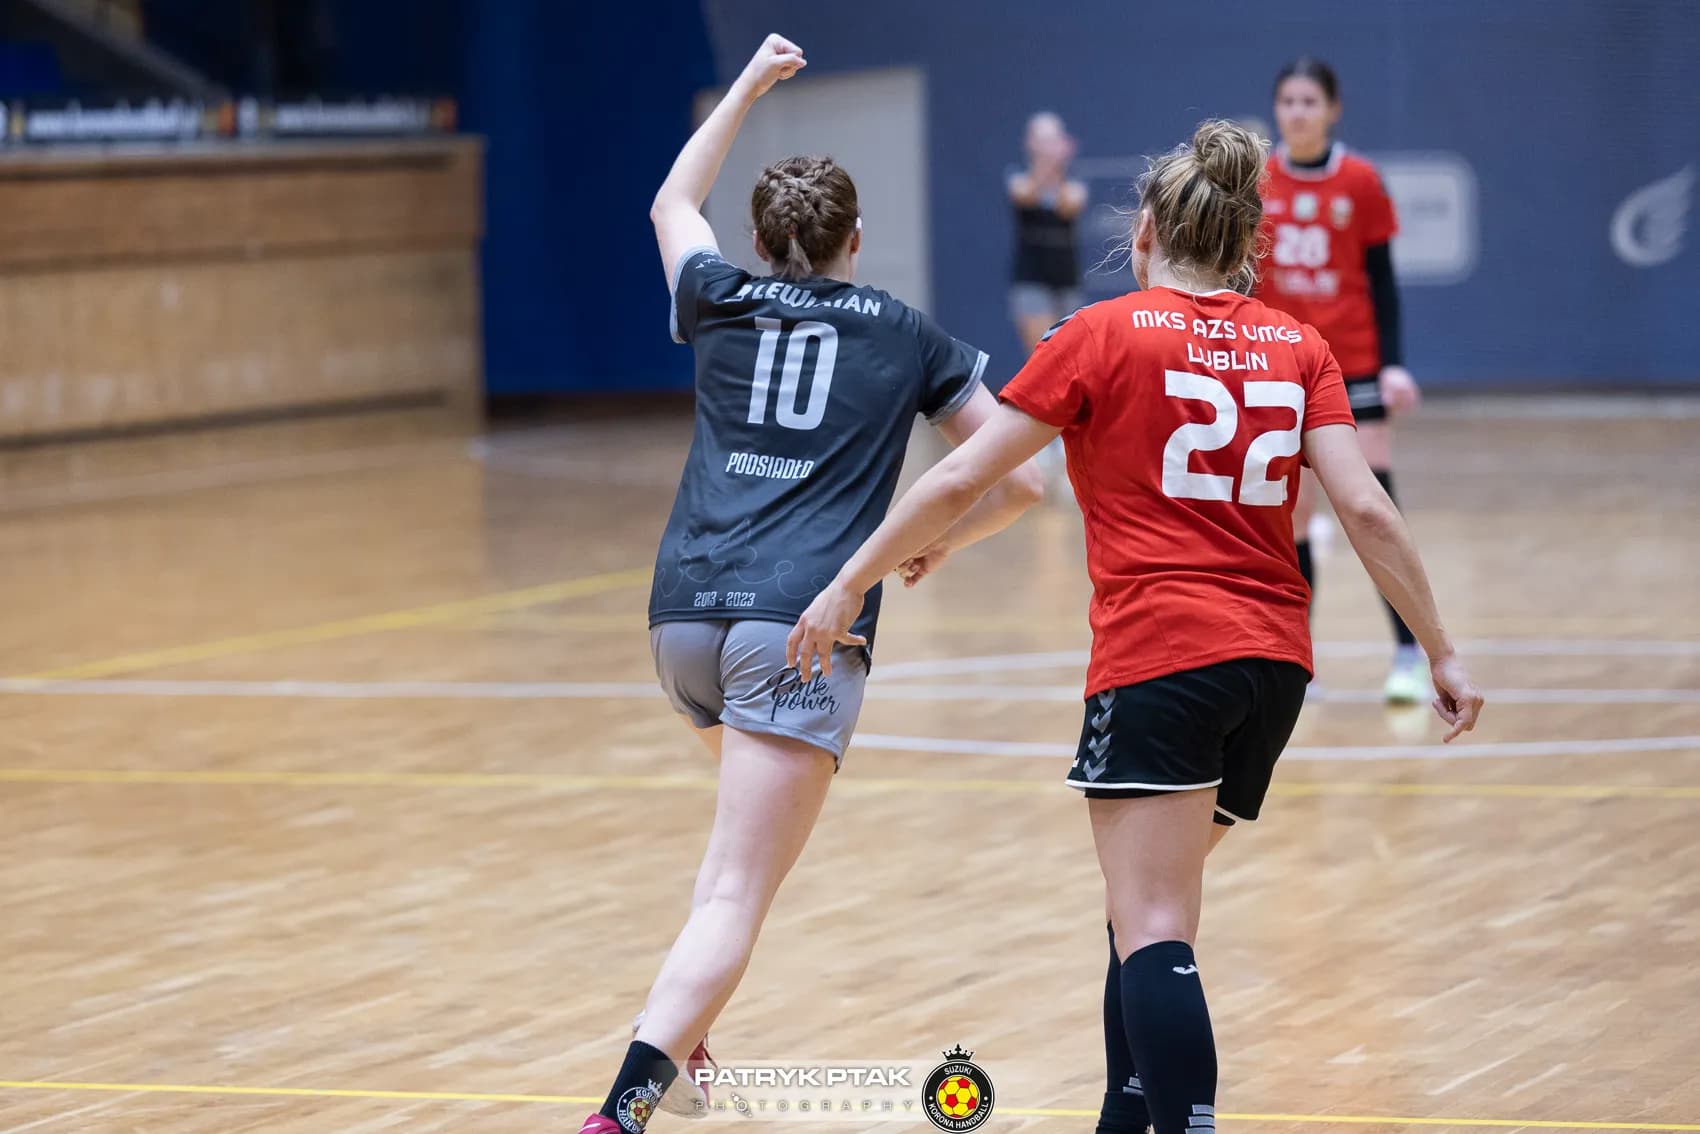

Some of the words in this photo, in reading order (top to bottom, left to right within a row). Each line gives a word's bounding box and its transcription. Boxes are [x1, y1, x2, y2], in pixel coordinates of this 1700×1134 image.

[1132, 310, 1187, 331] MKS
[1193, 319, 1237, 340] AZS
[1241, 324, 1303, 344] UMCS
[1187, 342, 1269, 371] LUBLIN
[747, 316, 839, 430] 10
[1162, 369, 1306, 506] 22
[725, 452, 815, 479] PODSIADŁO
[725, 591, 756, 607] 2023
[771, 692, 840, 722] power
